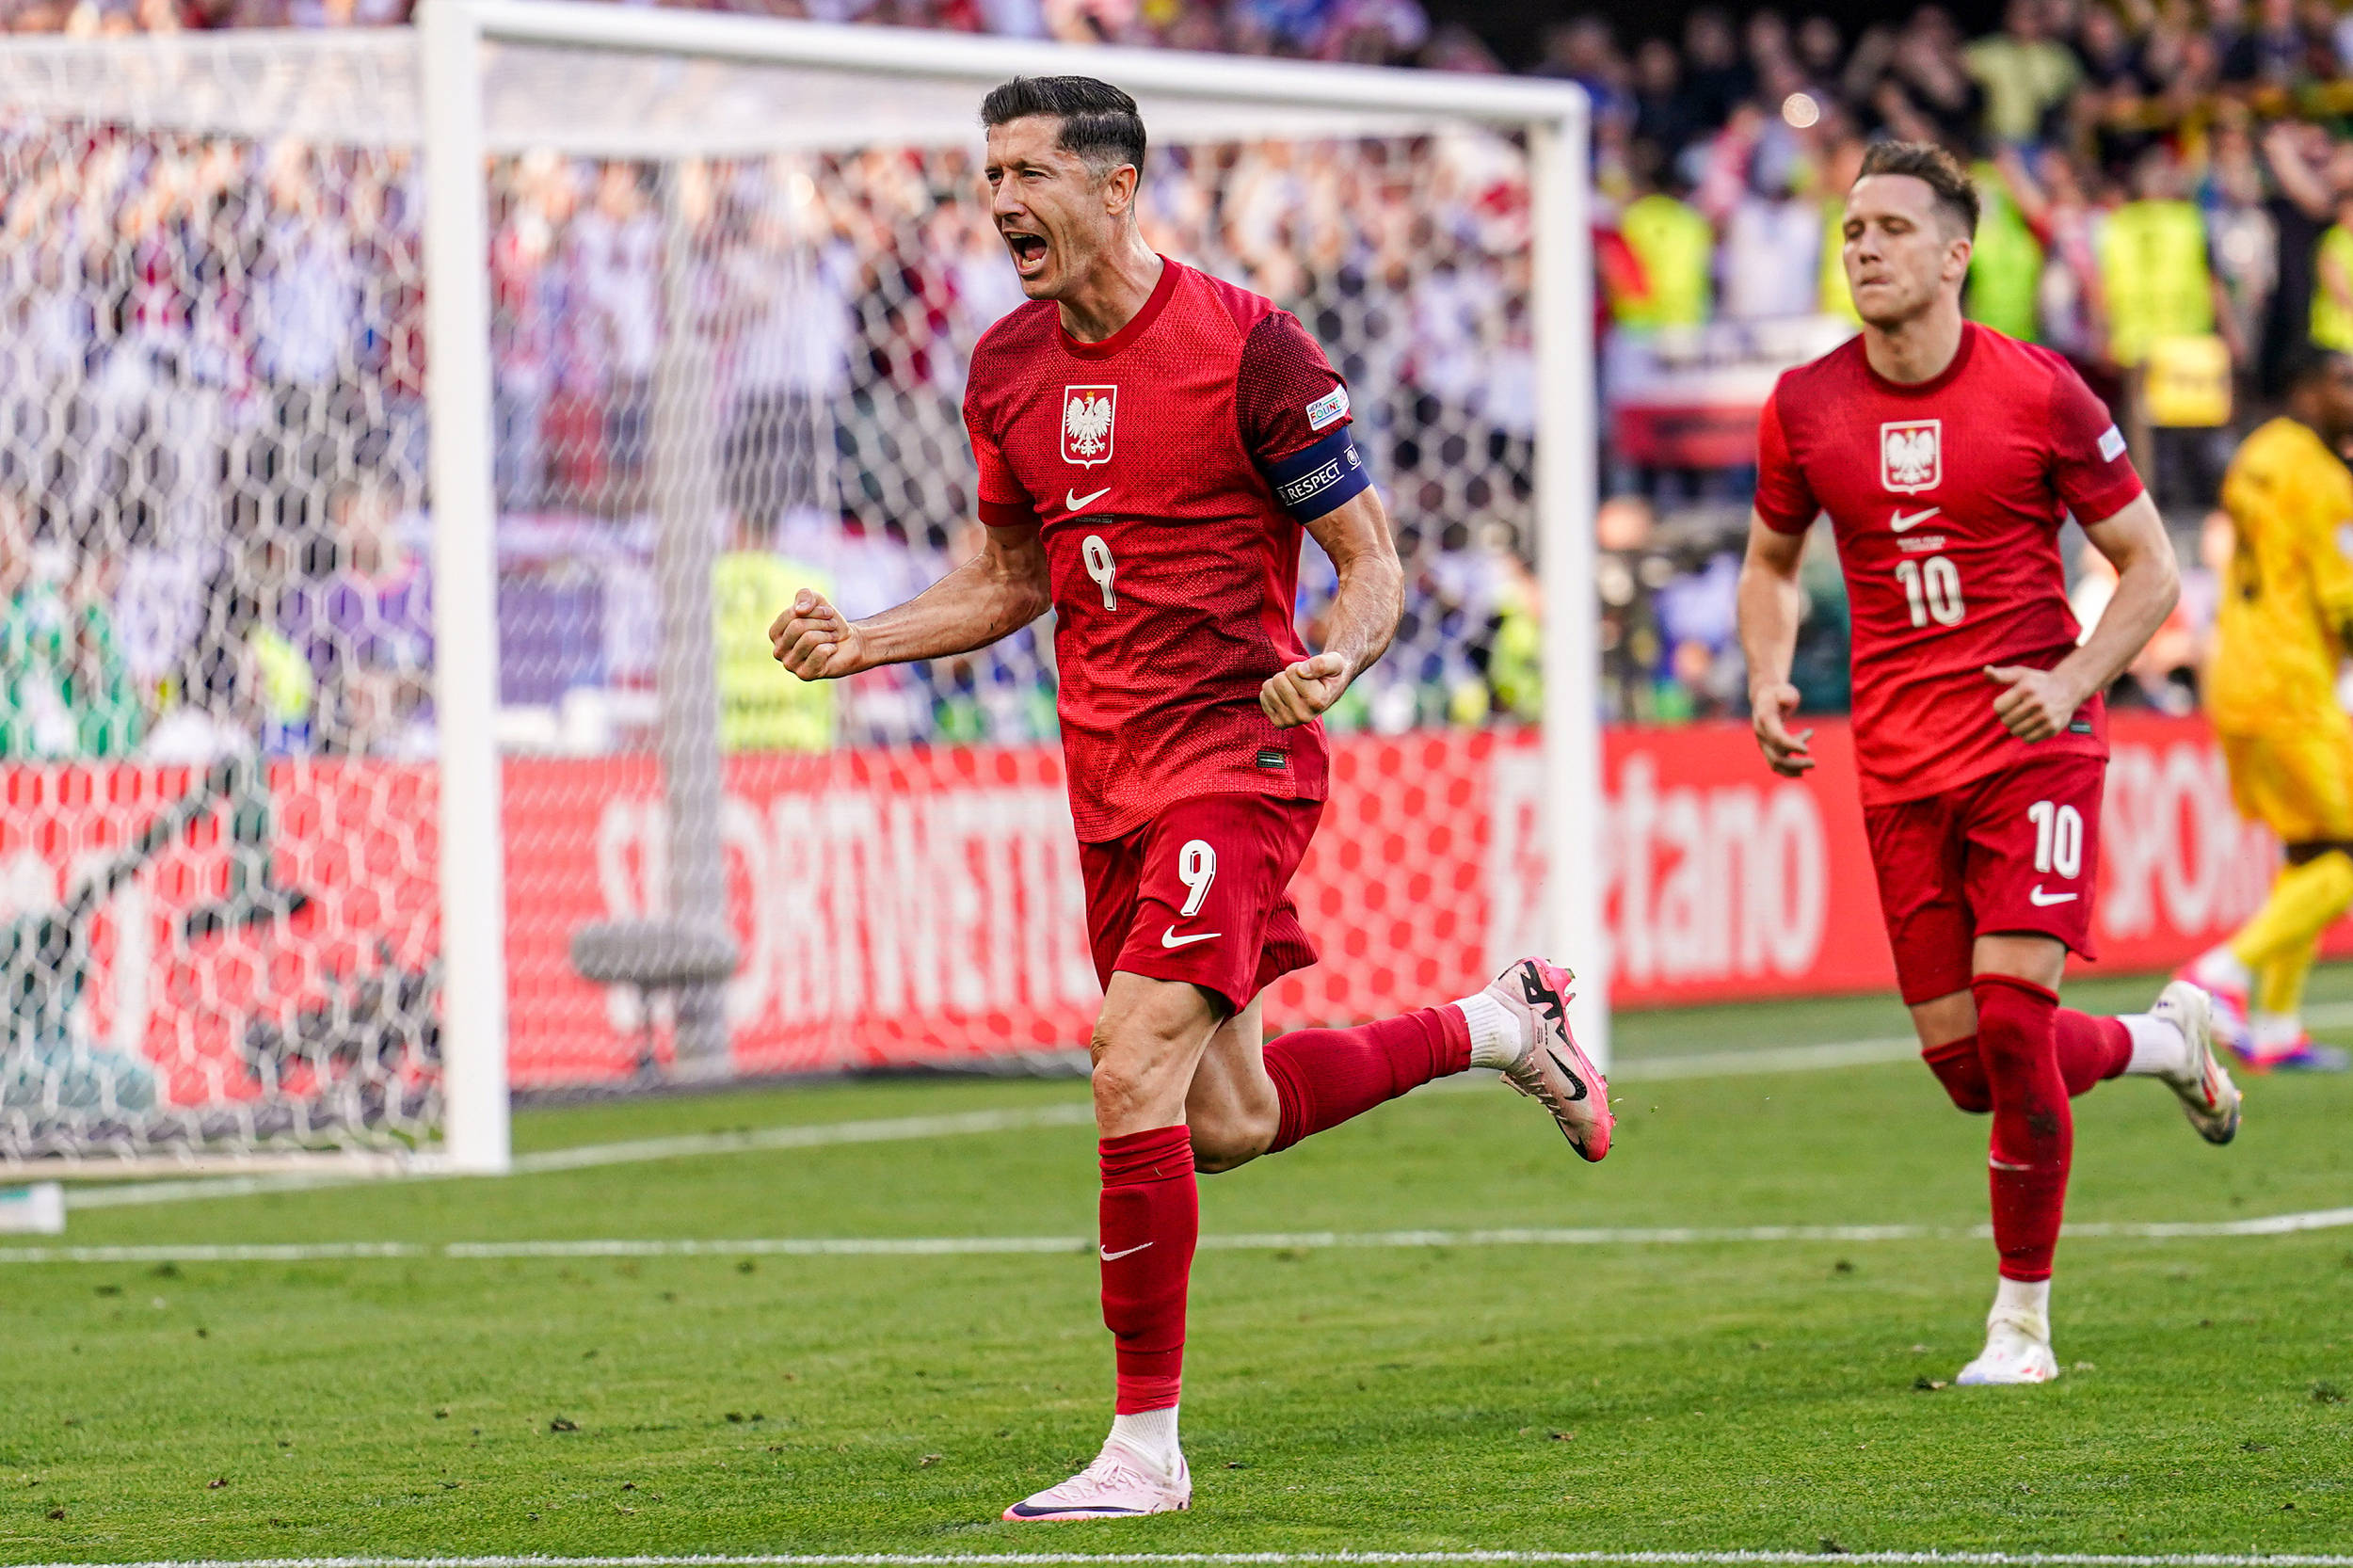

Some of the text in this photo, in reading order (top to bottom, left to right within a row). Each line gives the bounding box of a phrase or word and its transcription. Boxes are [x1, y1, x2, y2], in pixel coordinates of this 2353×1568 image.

[1288, 462, 1340, 500] RESPECT
[1082, 535, 1117, 612] 9
[1895, 555, 1966, 629] 10
[1179, 839, 1217, 916] 9
[1491, 748, 1830, 986] Btano
[2027, 800, 2084, 880] 10
